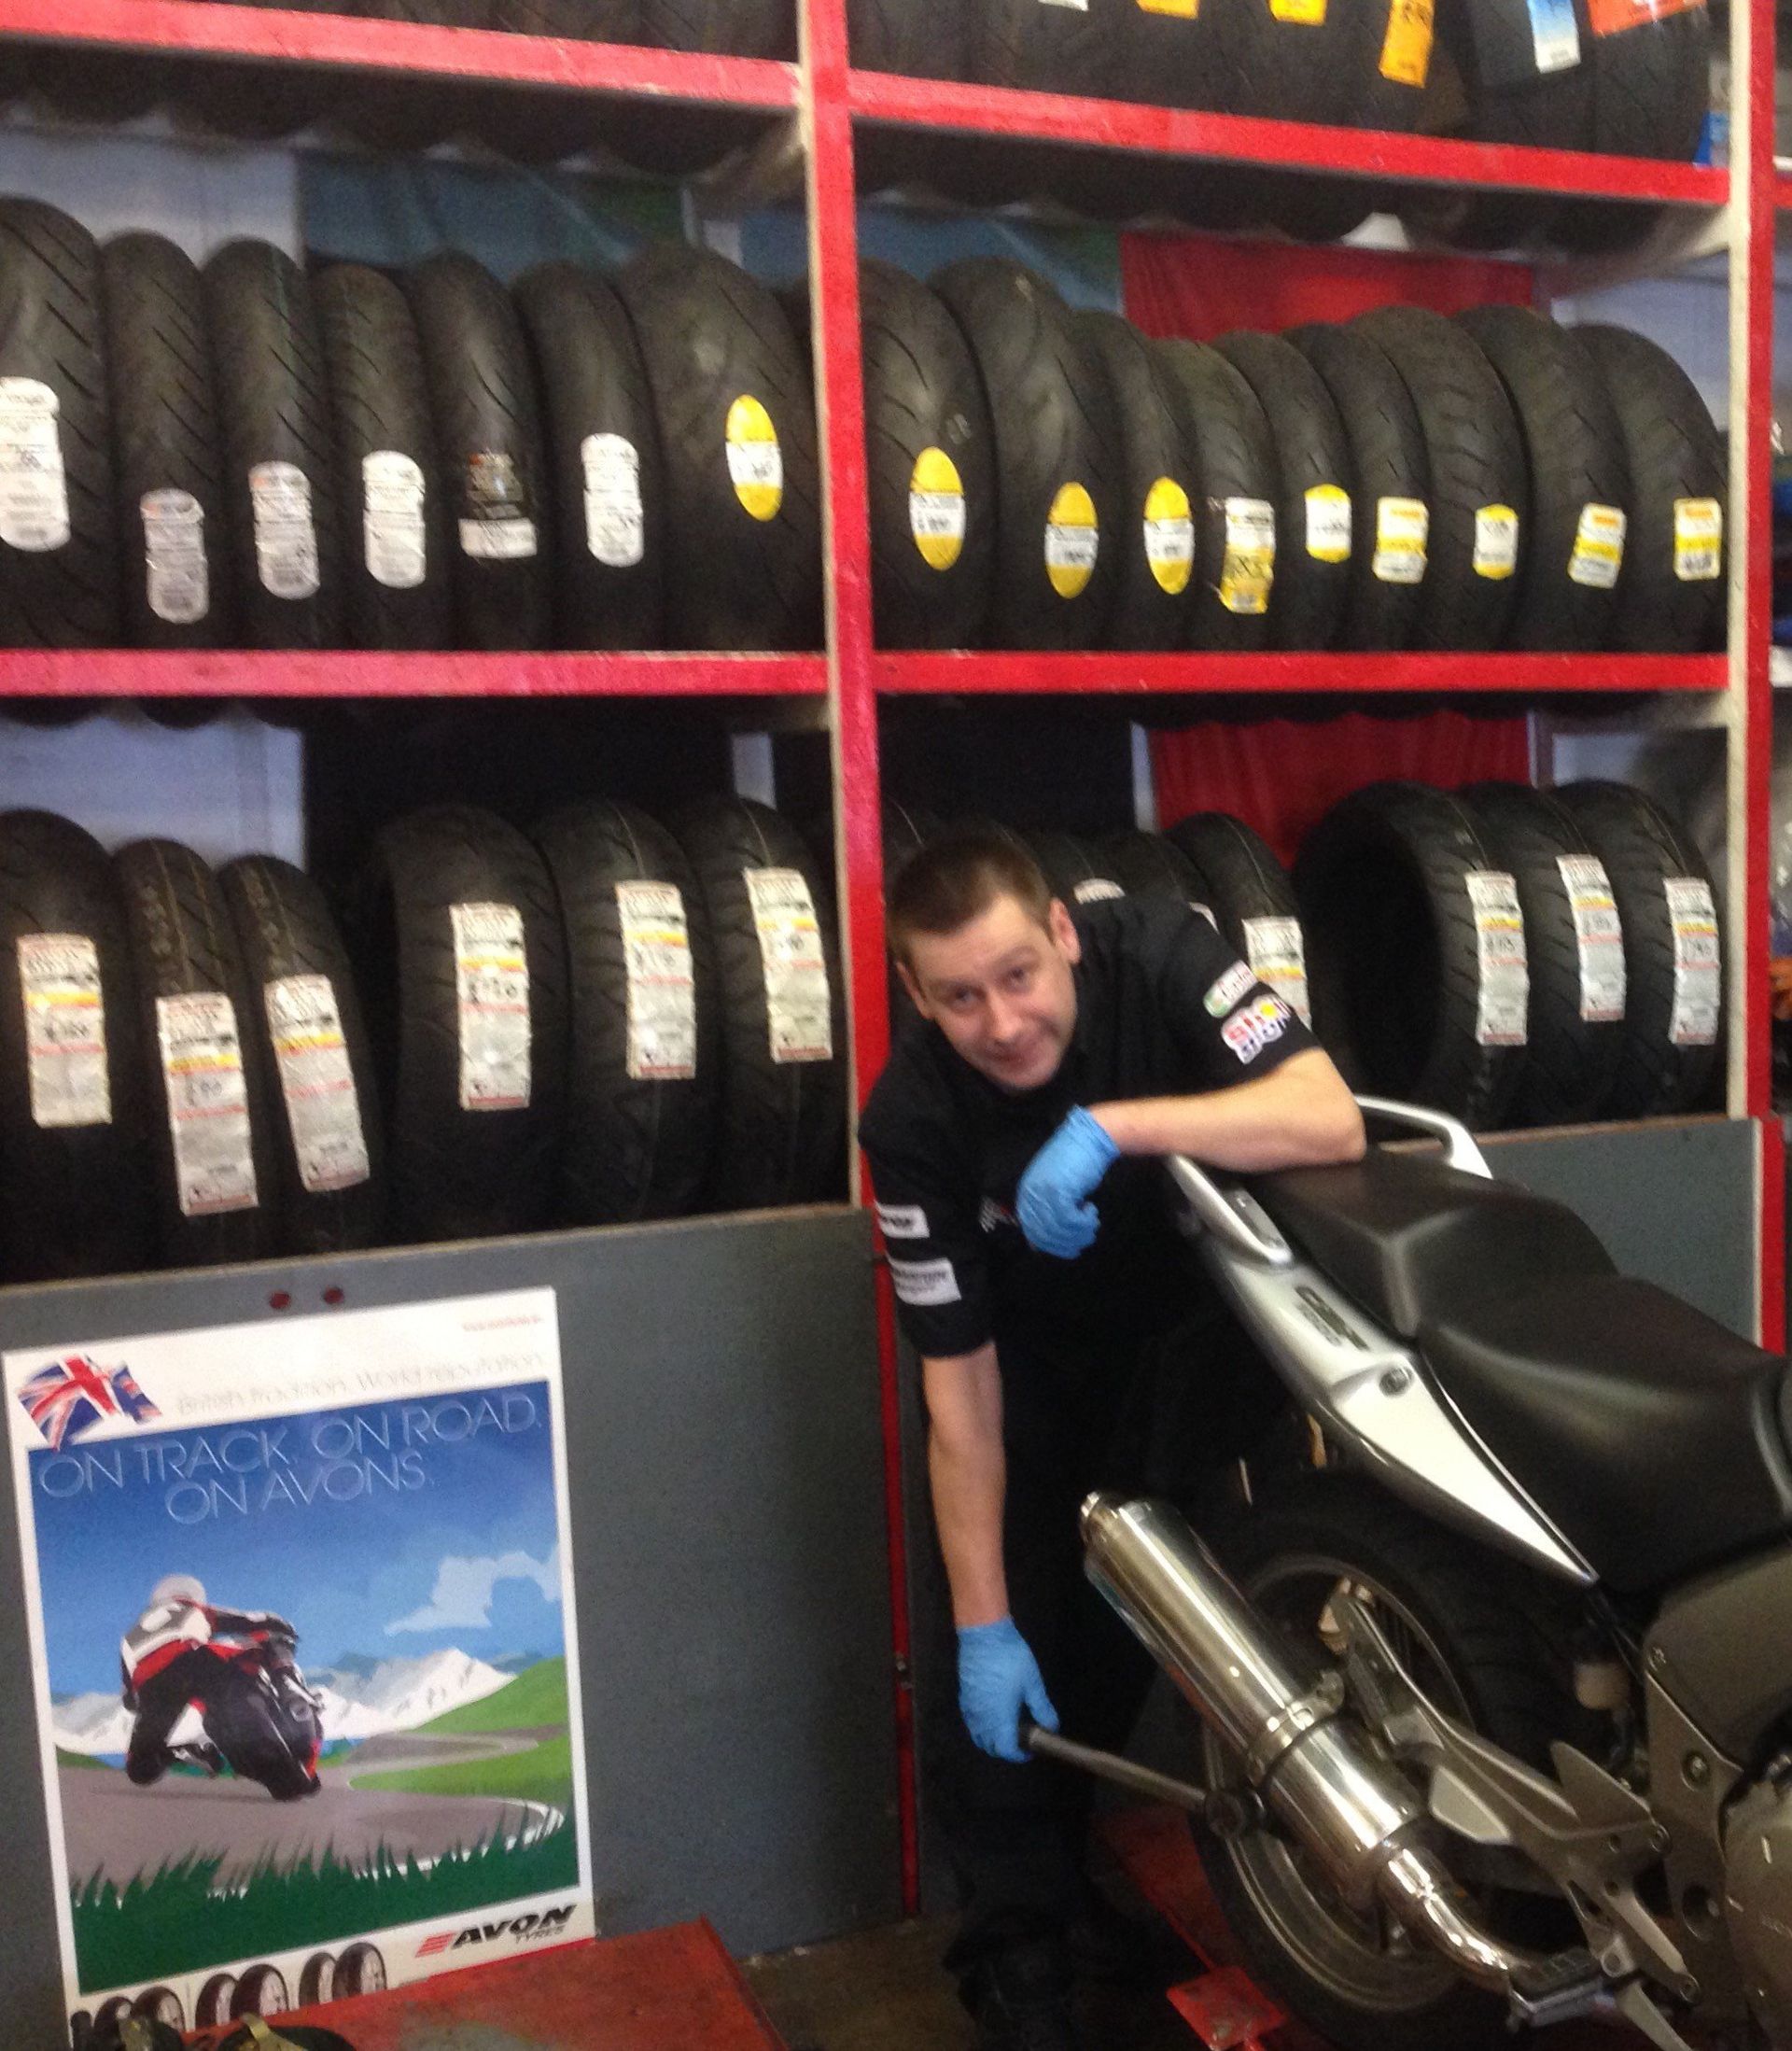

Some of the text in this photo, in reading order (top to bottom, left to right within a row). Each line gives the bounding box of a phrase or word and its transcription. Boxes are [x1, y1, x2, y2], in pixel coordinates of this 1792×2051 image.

[39, 1449, 123, 1497] ON
[311, 1410, 389, 1460] ON
[165, 1477, 247, 1525] ON
[451, 1904, 577, 1949] AVON
